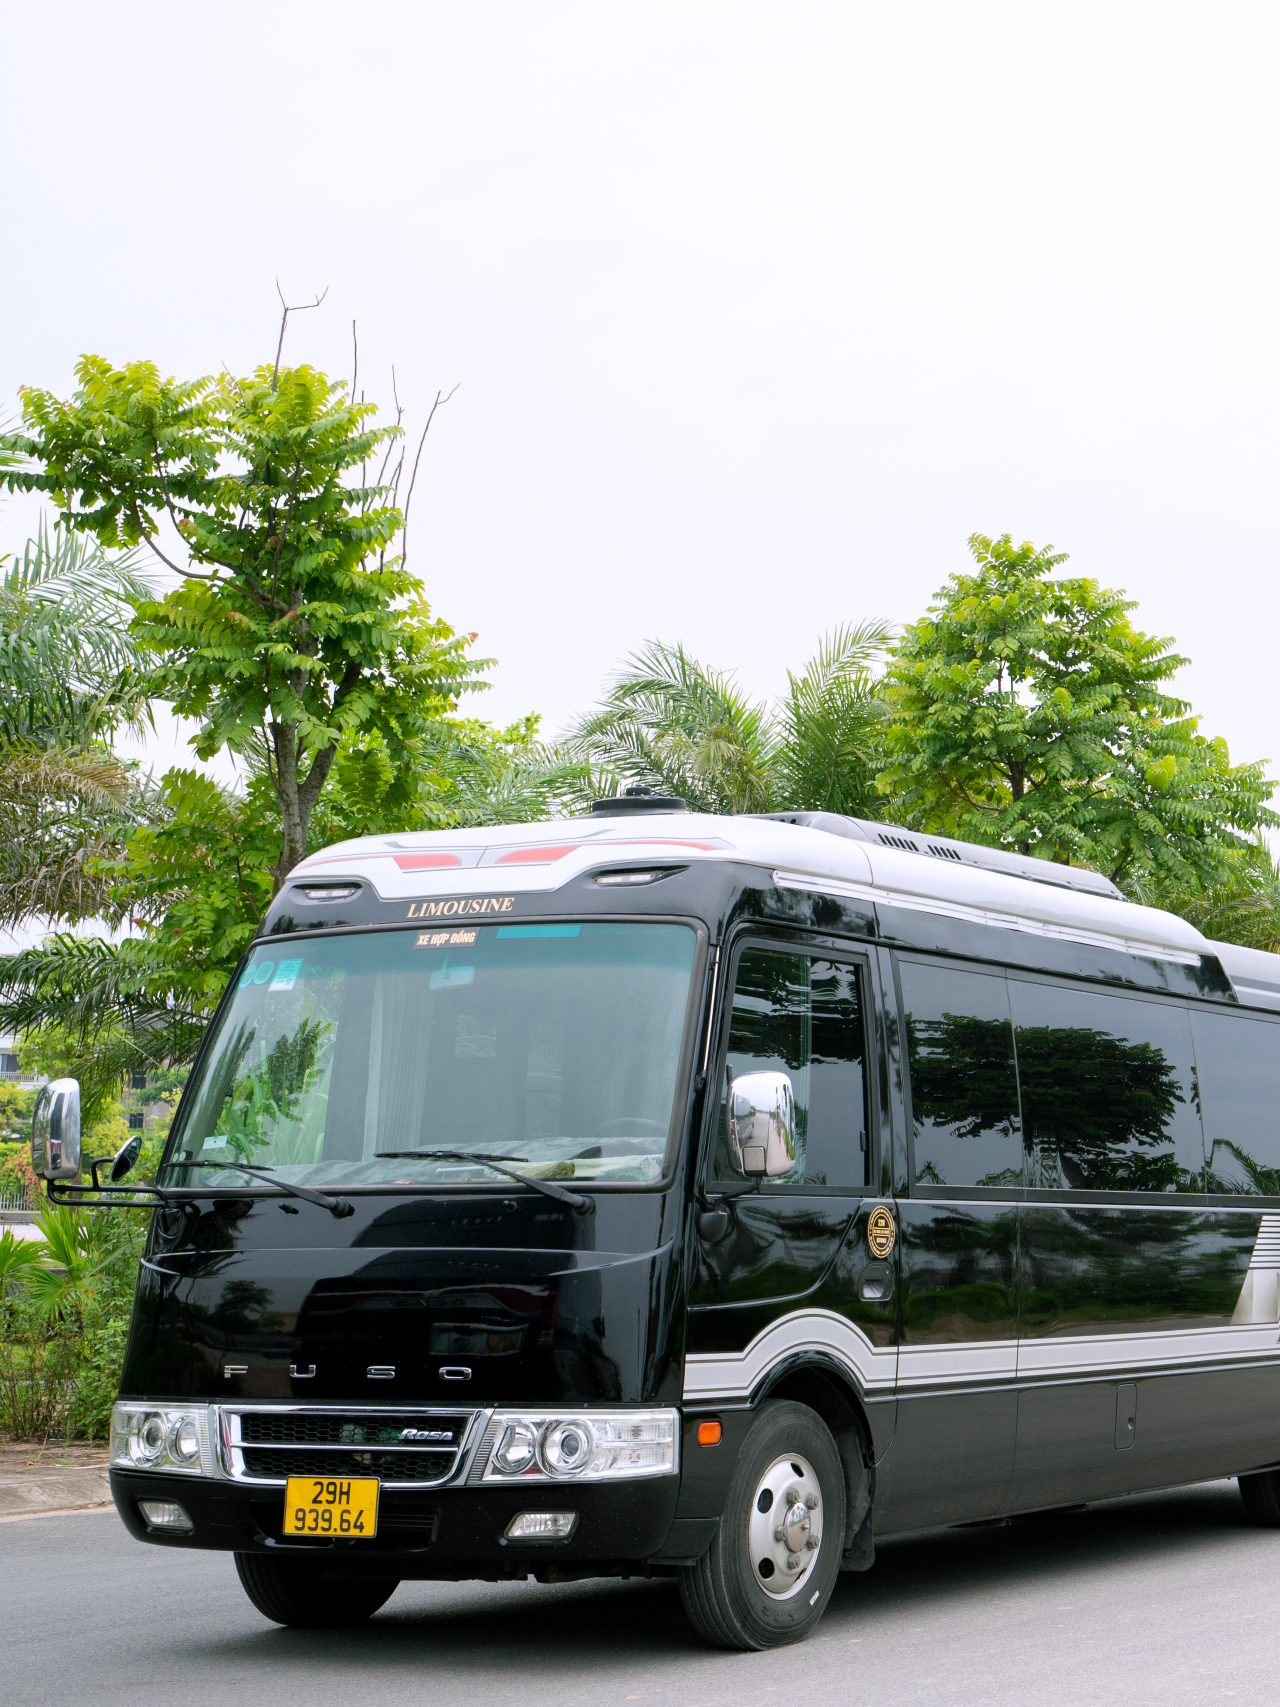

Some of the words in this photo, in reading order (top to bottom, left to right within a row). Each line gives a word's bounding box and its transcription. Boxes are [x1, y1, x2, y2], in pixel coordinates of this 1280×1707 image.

[407, 897, 515, 918] LIMOUSINE
[417, 934, 430, 946] XE
[430, 932, 449, 947] HỢP
[224, 1364, 472, 1380] FUSO
[311, 1481, 350, 1505] 29H
[293, 1507, 365, 1533] 939.64
